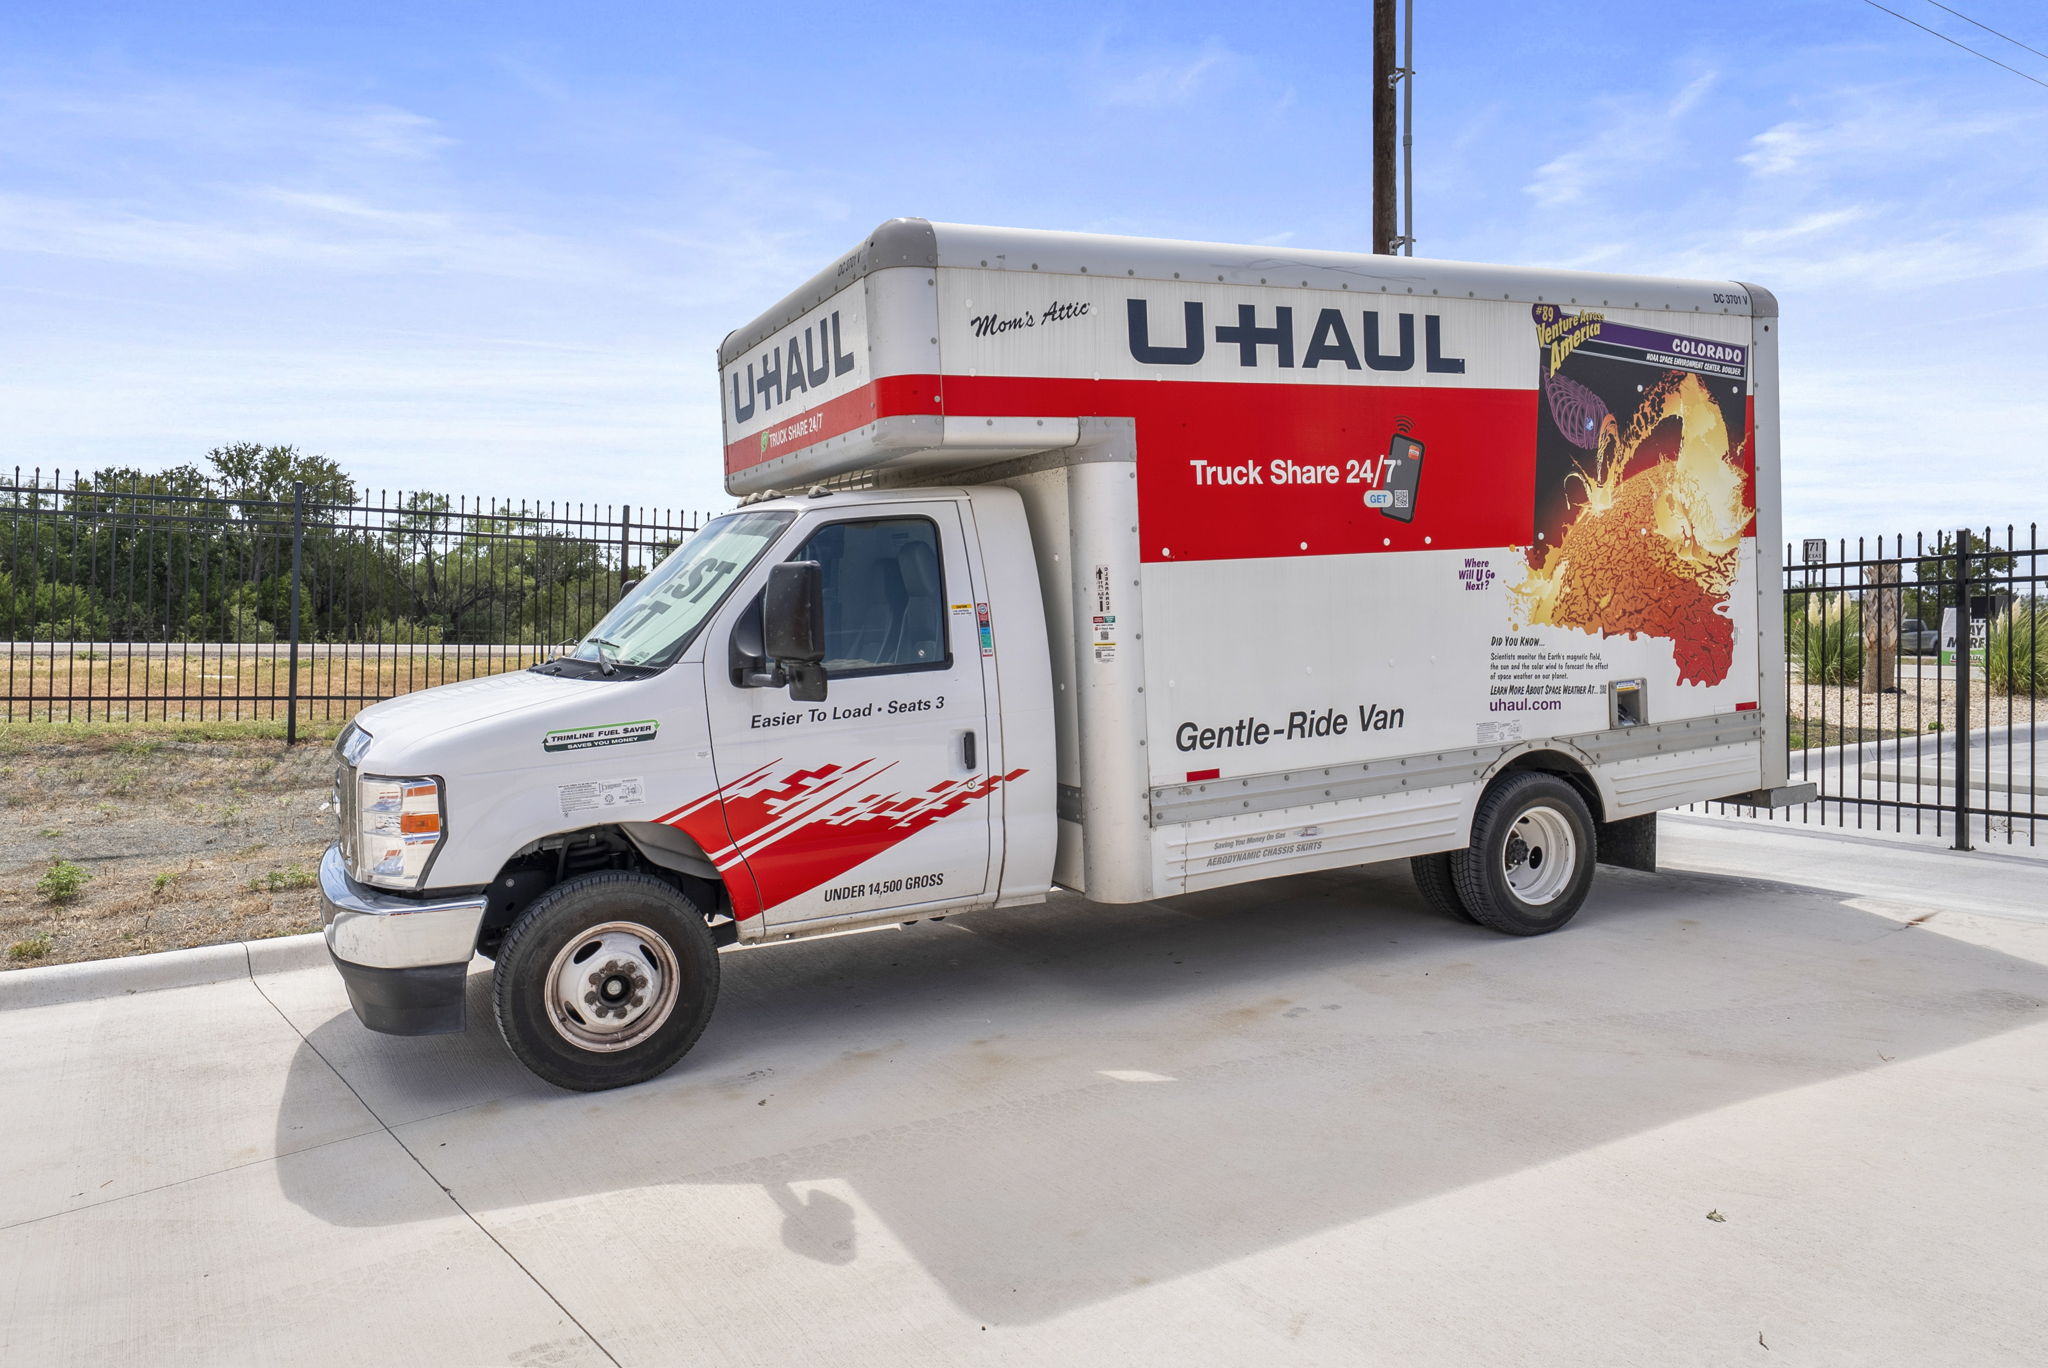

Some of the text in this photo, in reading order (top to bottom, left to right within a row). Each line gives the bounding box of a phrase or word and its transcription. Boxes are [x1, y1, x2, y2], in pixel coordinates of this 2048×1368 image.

[1713, 293, 1748, 305] DC 3701 V
[970, 300, 1088, 338] Mom's Attic
[1535, 305, 1554, 323] #89
[1536, 315, 1579, 349] Venture
[1550, 322, 1601, 379] America
[1672, 338, 1742, 363] COLORADO
[1659, 354, 1674, 365] SPACE
[1673, 357, 1704, 370] ENVIRONMENT
[1721, 366, 1742, 376] BOULDER
[769, 412, 823, 448] TRUCK SHARE 24/7
[1190, 454, 1397, 488] Truck Share 24/7
[1369, 493, 1388, 505] GET
[1464, 558, 1489, 568] Where
[1458, 569, 1495, 582] Will U Go
[1465, 580, 1490, 591] Next?
[1490, 636, 1503, 647] DID
[1504, 636, 1518, 647] YOU
[1946, 637, 1985, 649] MRE
[1490, 652, 1516, 661] Scientists
[1517, 653, 1537, 661] monitor
[1538, 653, 1546, 661] the
[1547, 652, 1565, 661] Earth's
[1566, 653, 1588, 662] magnetic
[1490, 662, 1499, 671] the
[1511, 662, 1520, 671] and
[1521, 662, 1530, 671] the
[1531, 662, 1544, 671] solar
[1545, 662, 1557, 671] wind
[1558, 663, 1564, 671] to
[1565, 663, 1584, 671] forecast
[1585, 662, 1594, 671] the
[1595, 662, 1609, 670] effect
[1490, 672, 1496, 681] of
[1497, 673, 1512, 682] space
[1513, 672, 1533, 680] weather
[1552, 672, 1569, 681] planet.
[1490, 685, 1508, 696] LEARN
[1508, 684, 1525, 696] MORE
[1525, 684, 1544, 695] ABOUT
[1545, 684, 1562, 695] SPACE
[1562, 684, 1587, 695] WEATHER
[750, 696, 945, 729] Easier To Load Seats 3
[1489, 698, 1562, 712] uhaul.com
[551, 725, 652, 742] TRIMLINE FUEL SAVER
[1175, 704, 1405, 752] Gentle-Ride Van
[567, 742, 593, 750] SAVES
[611, 736, 639, 744] MONEY
[1214, 832, 1286, 850] Saving You Money On Gas
[1206, 841, 1322, 867] AERODYNAMIC CHASSIS SKIRTS
[824, 873, 944, 903] UNDER 14,500 GROSS
